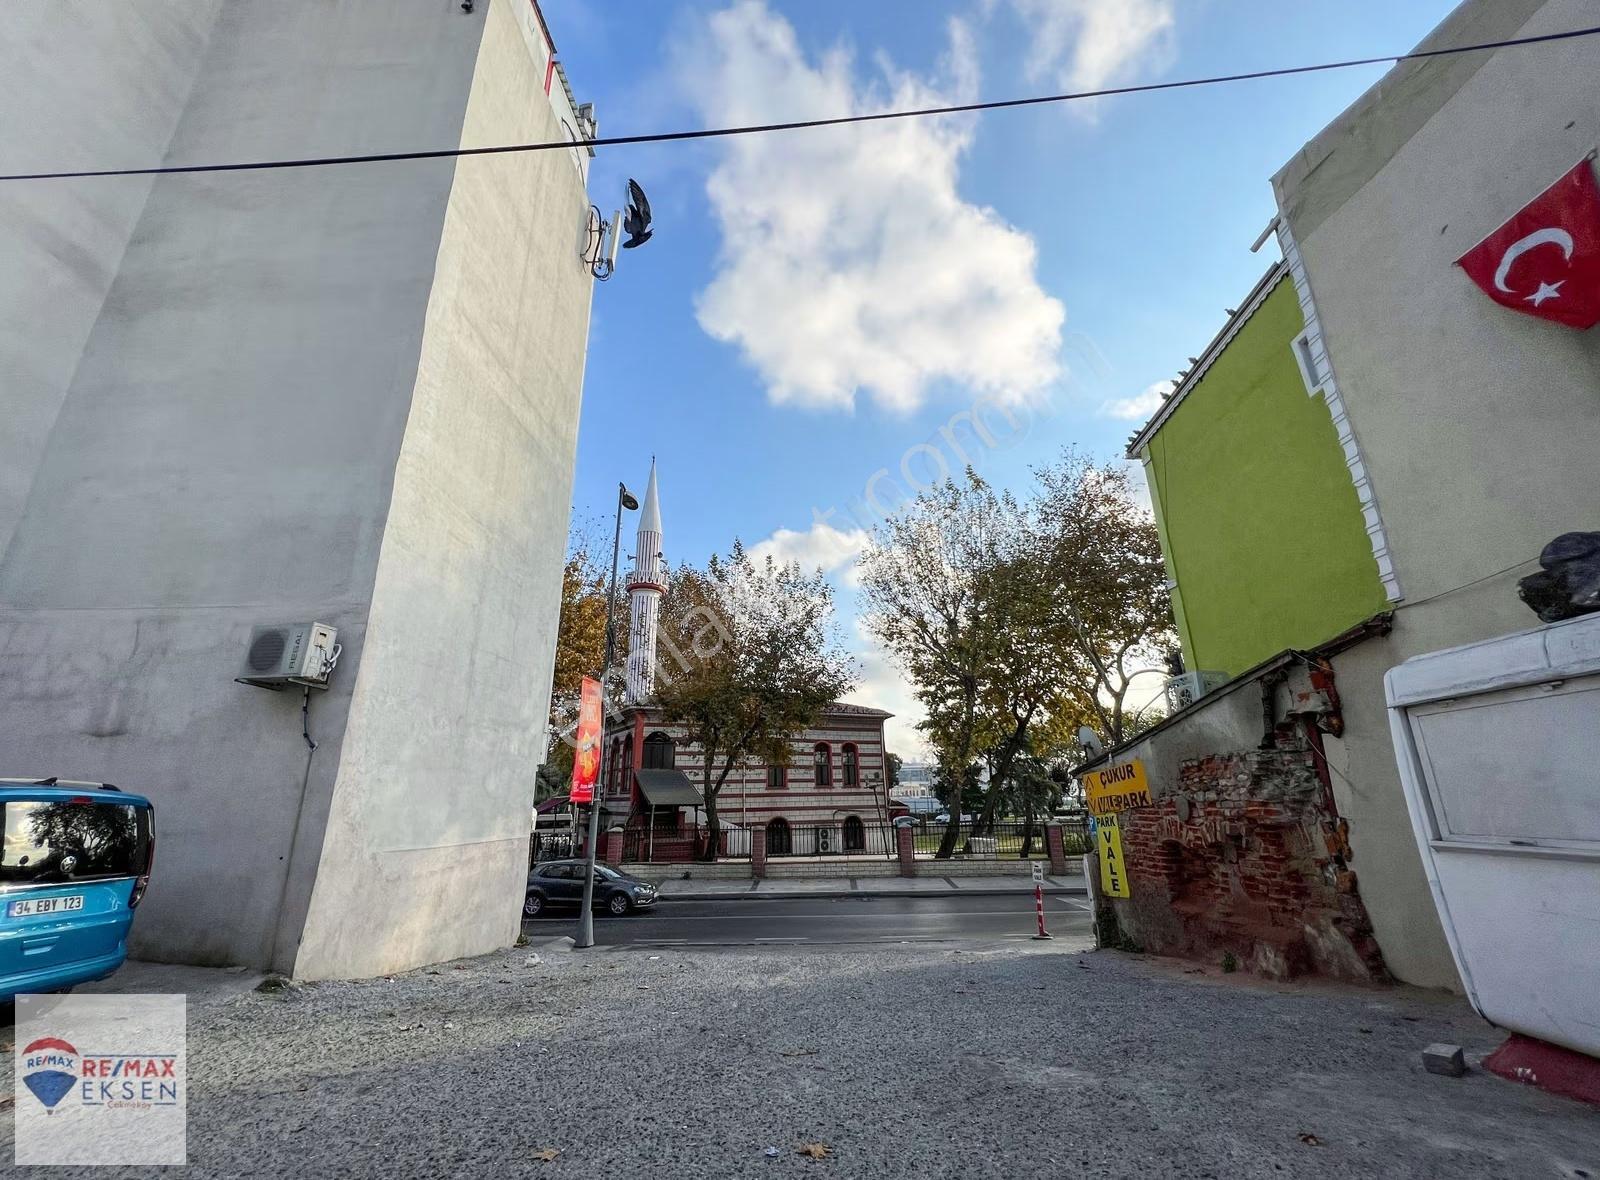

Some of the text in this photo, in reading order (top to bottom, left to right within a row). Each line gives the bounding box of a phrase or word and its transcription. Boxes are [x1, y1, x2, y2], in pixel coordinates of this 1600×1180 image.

[1100, 763, 1136, 789] ÇUKUR
[1096, 815, 1116, 828] PARK
[1103, 831, 1121, 892] VALE
[15, 897, 81, 915] 34 EBY 123
